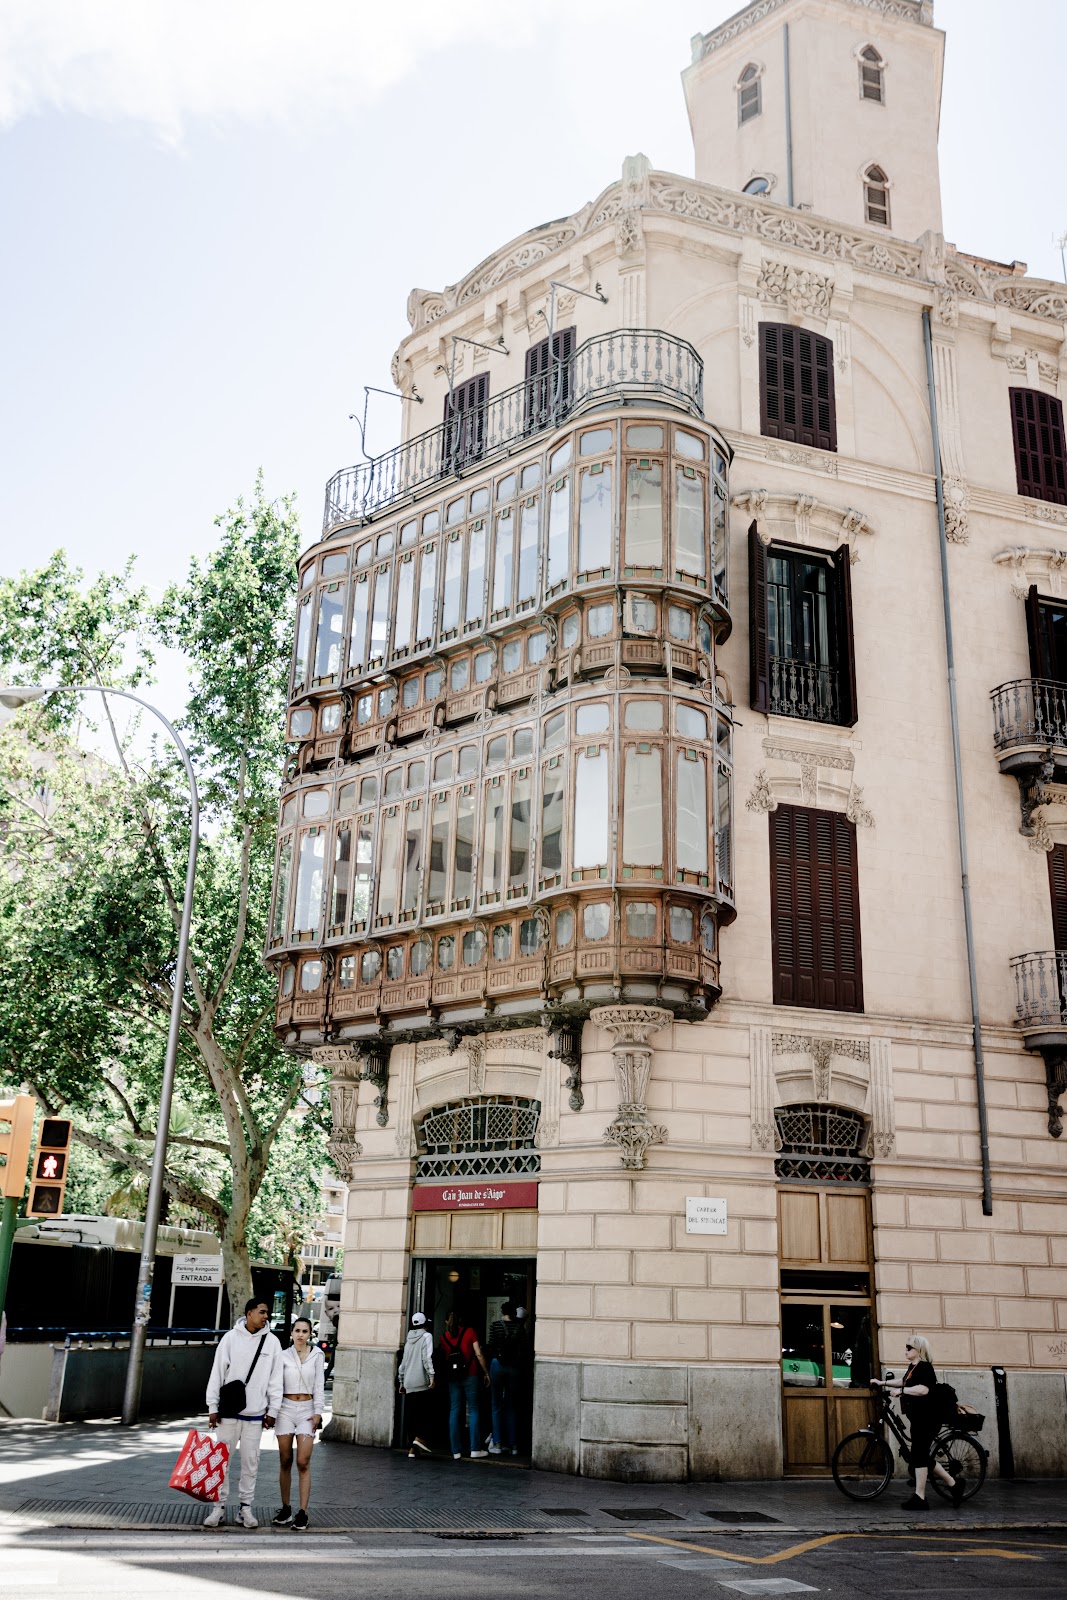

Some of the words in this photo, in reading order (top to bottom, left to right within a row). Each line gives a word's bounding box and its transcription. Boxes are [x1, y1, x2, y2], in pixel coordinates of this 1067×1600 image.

[456, 1189, 473, 1202] Joan
[474, 1189, 482, 1200] de
[180, 1274, 213, 1282] ENTRADA
